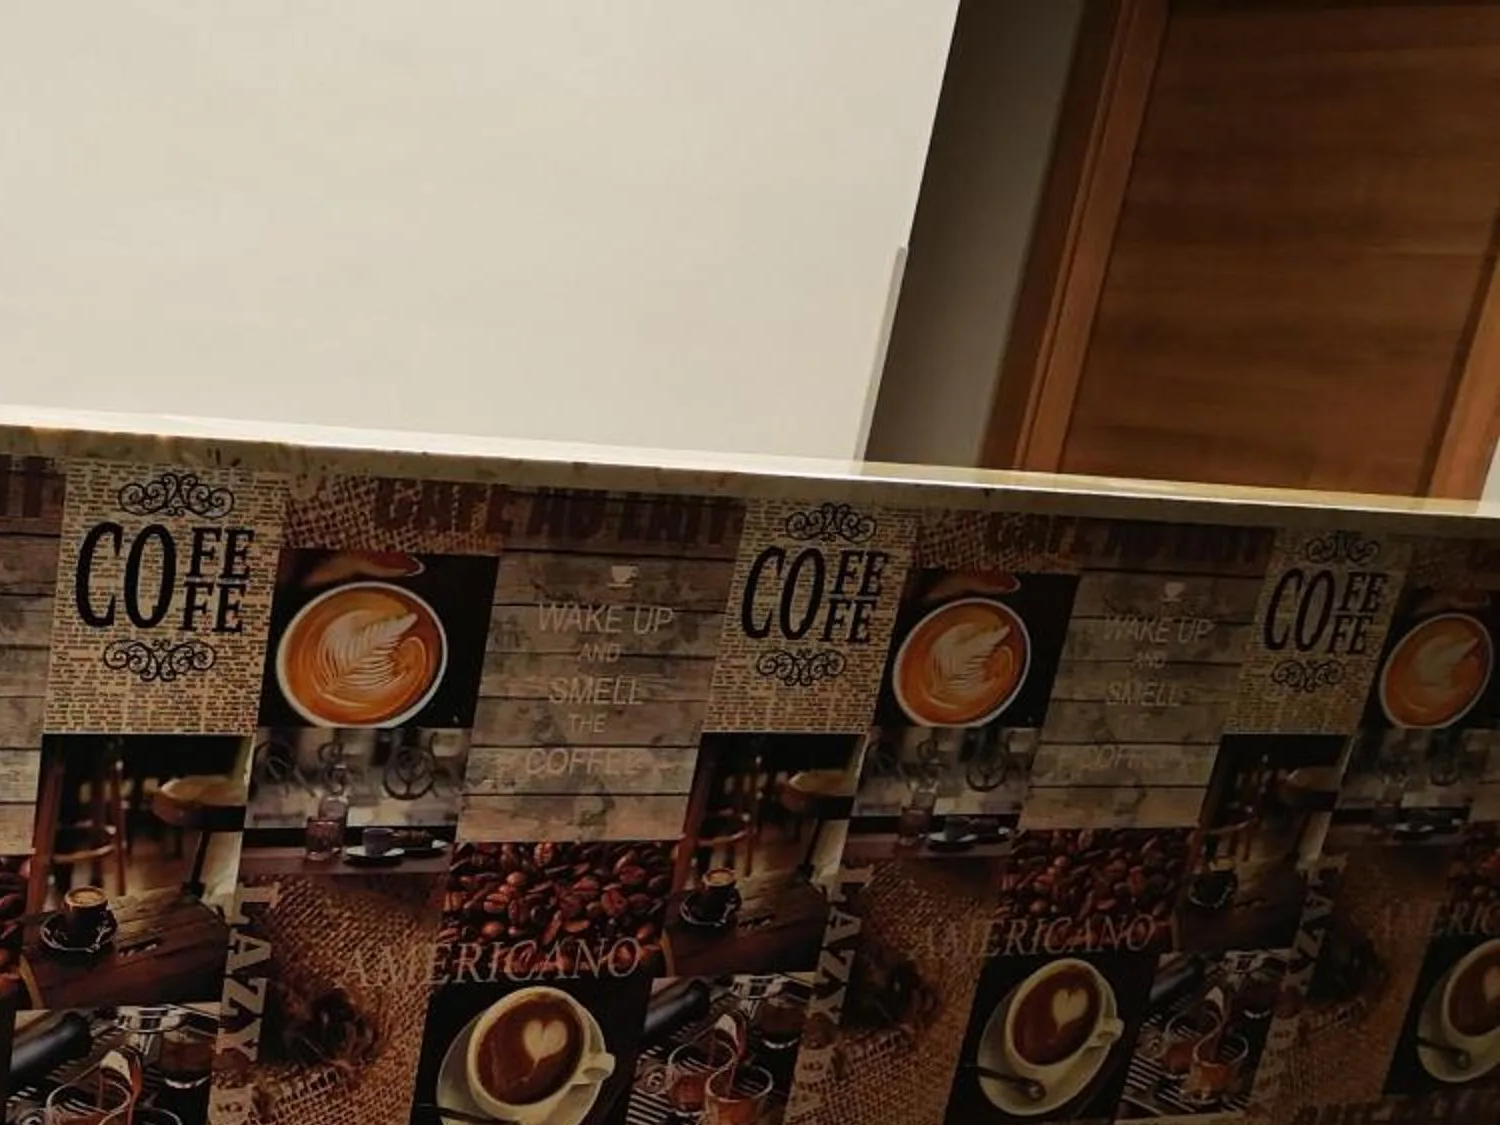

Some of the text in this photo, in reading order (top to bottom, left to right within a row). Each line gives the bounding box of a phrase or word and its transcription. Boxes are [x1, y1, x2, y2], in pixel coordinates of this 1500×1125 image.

[538, 602, 674, 635] WAKE UP
[577, 643, 621, 663] AND
[549, 677, 644, 705] SMELL
[568, 714, 607, 734] THE
[805, 863, 876, 1026] LAZY
[214, 882, 281, 1063] LAZY
